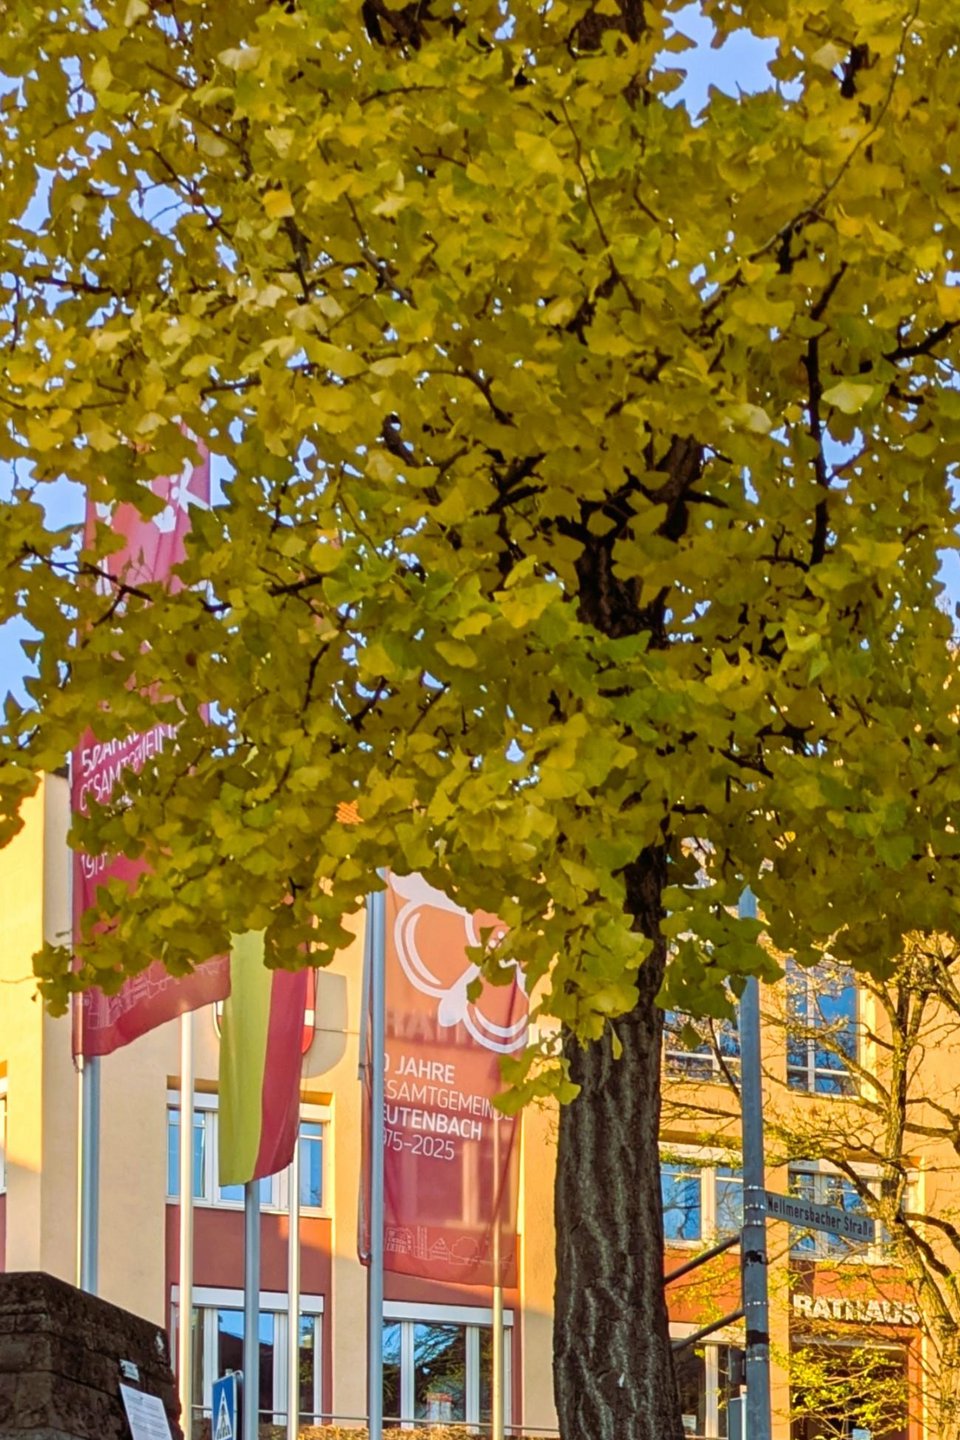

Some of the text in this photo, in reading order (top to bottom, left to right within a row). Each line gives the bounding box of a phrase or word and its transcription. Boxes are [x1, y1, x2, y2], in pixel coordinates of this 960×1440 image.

[394, 1055, 456, 1085] JAHRE
[383, 1078, 515, 1121] SAMTGEMEIN
[383, 1102, 483, 1141] UTENBACH
[383, 1126, 456, 1161] 75-2025
[843, 1215, 874, 1238] Straße
[792, 1293, 921, 1326] RATHAUS
